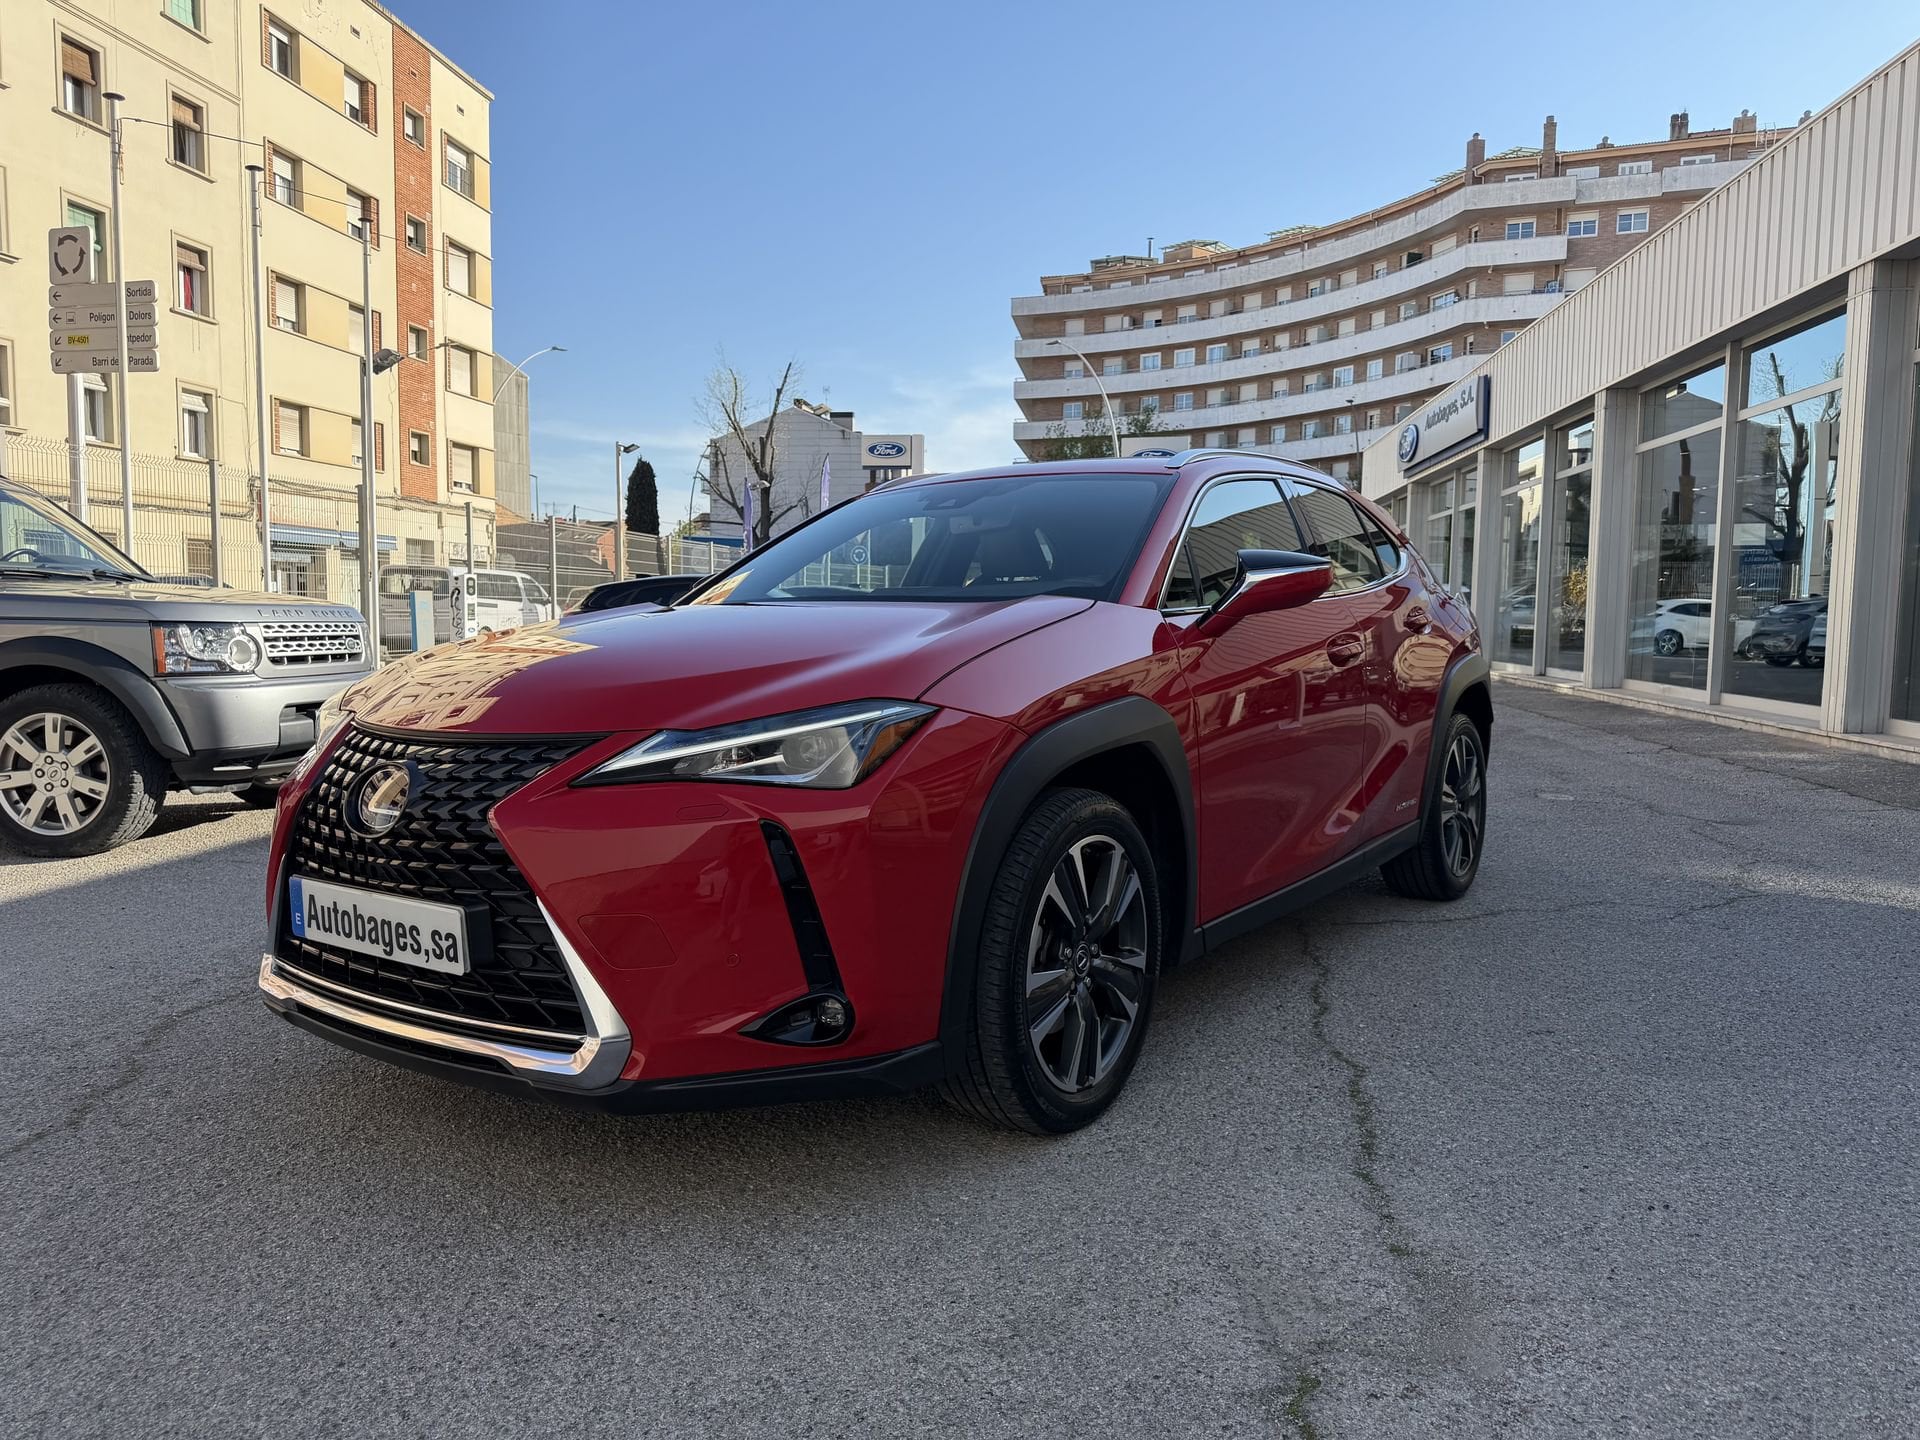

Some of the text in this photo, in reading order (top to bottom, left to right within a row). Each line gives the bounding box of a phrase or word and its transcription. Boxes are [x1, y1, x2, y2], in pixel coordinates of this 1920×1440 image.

[126, 287, 152, 297] Sortida
[129, 310, 152, 320] Dolors
[67, 333, 153, 345] BV-4501 ntpedor
[92, 356, 109, 366] Barri
[128, 355, 154, 367] Parada
[873, 444, 898, 456] Ford
[295, 912, 302, 925] E
[307, 893, 459, 964] Autobages,sa
